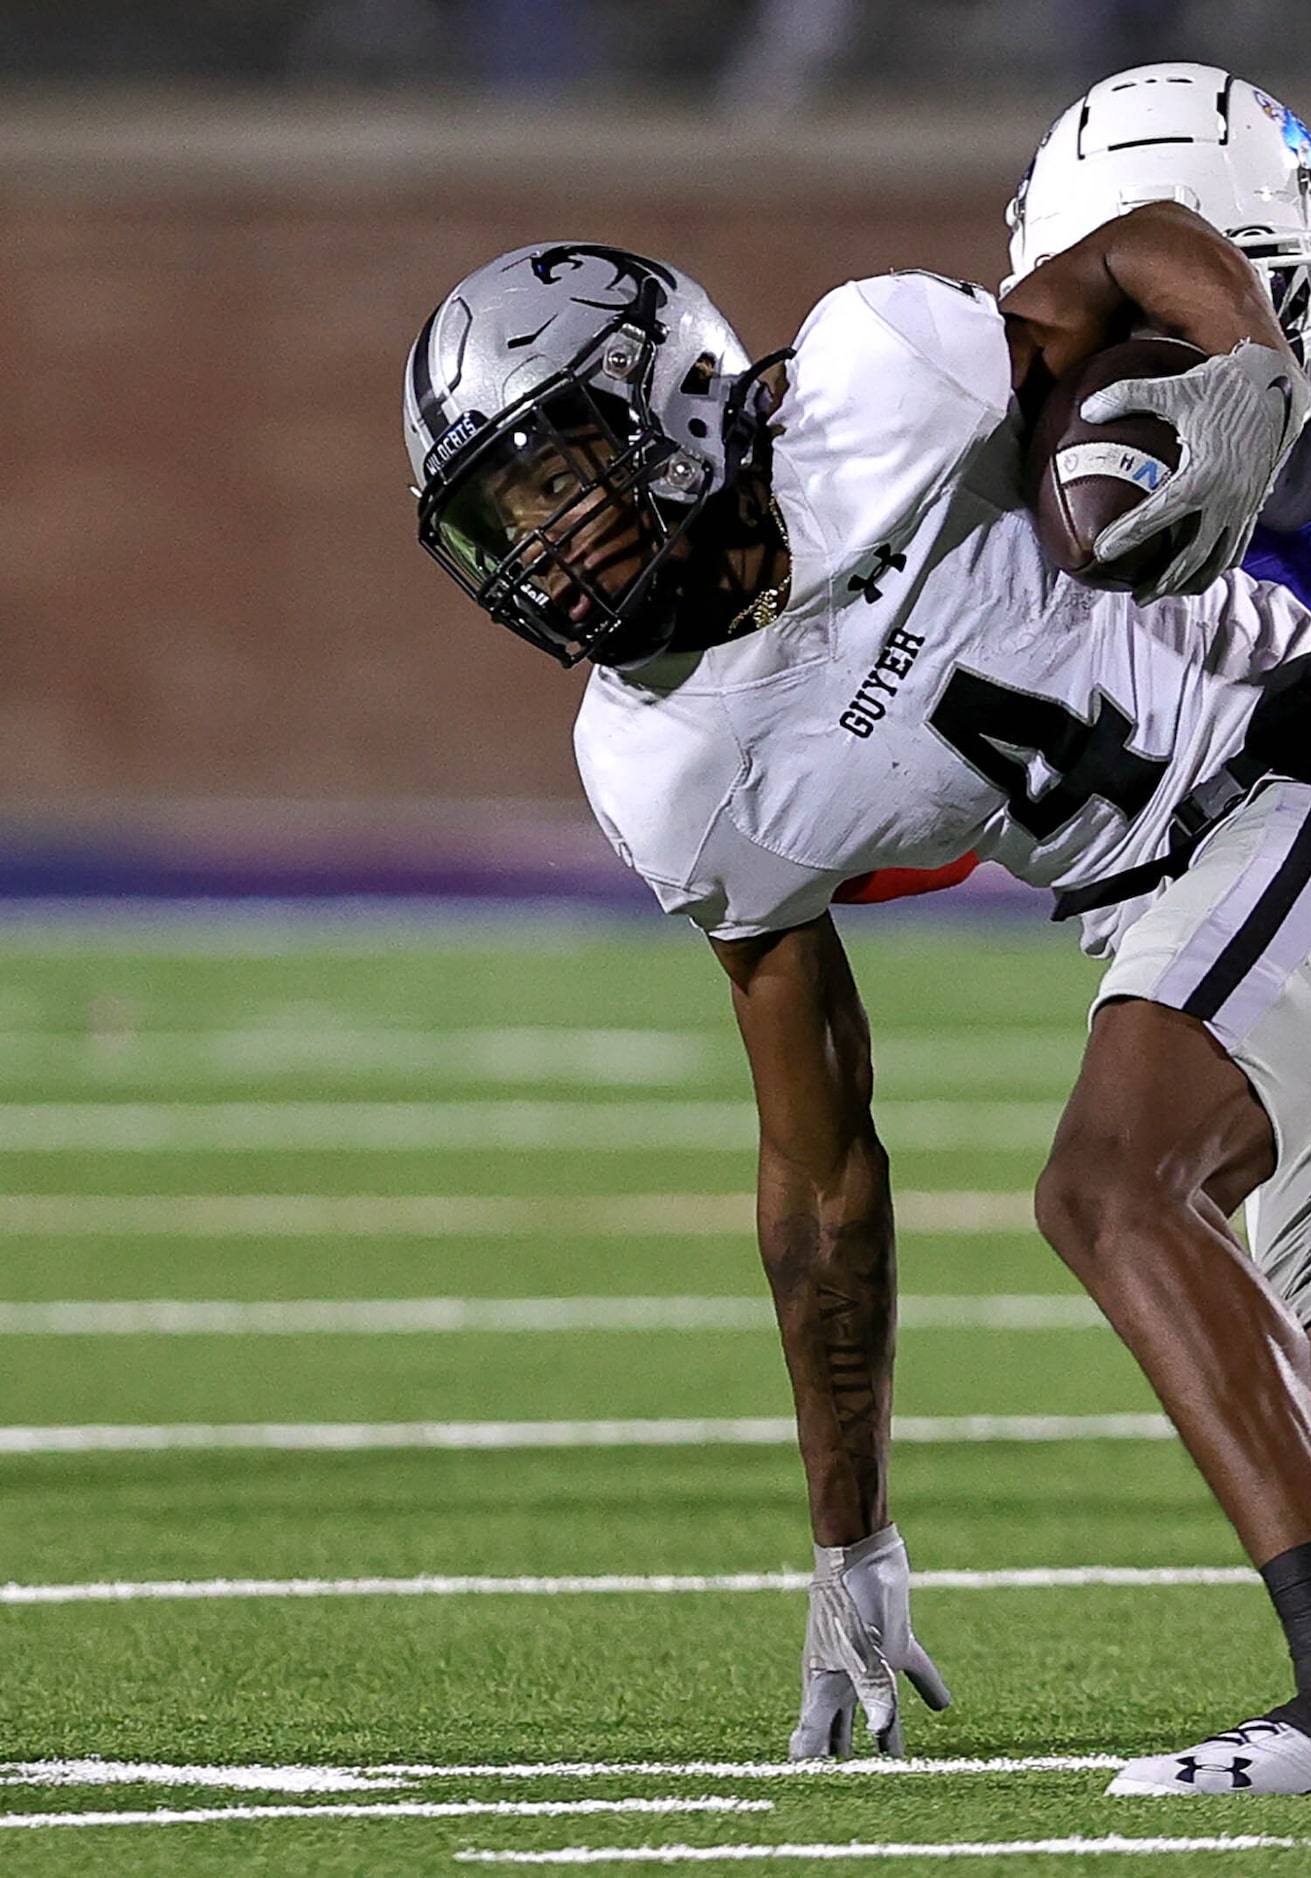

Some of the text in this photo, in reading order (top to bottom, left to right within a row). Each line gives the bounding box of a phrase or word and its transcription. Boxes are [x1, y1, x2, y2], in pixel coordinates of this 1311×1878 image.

[425, 417, 477, 476] WILDCATS
[839, 629, 925, 739] GUYER
[923, 660, 1173, 846] 4
